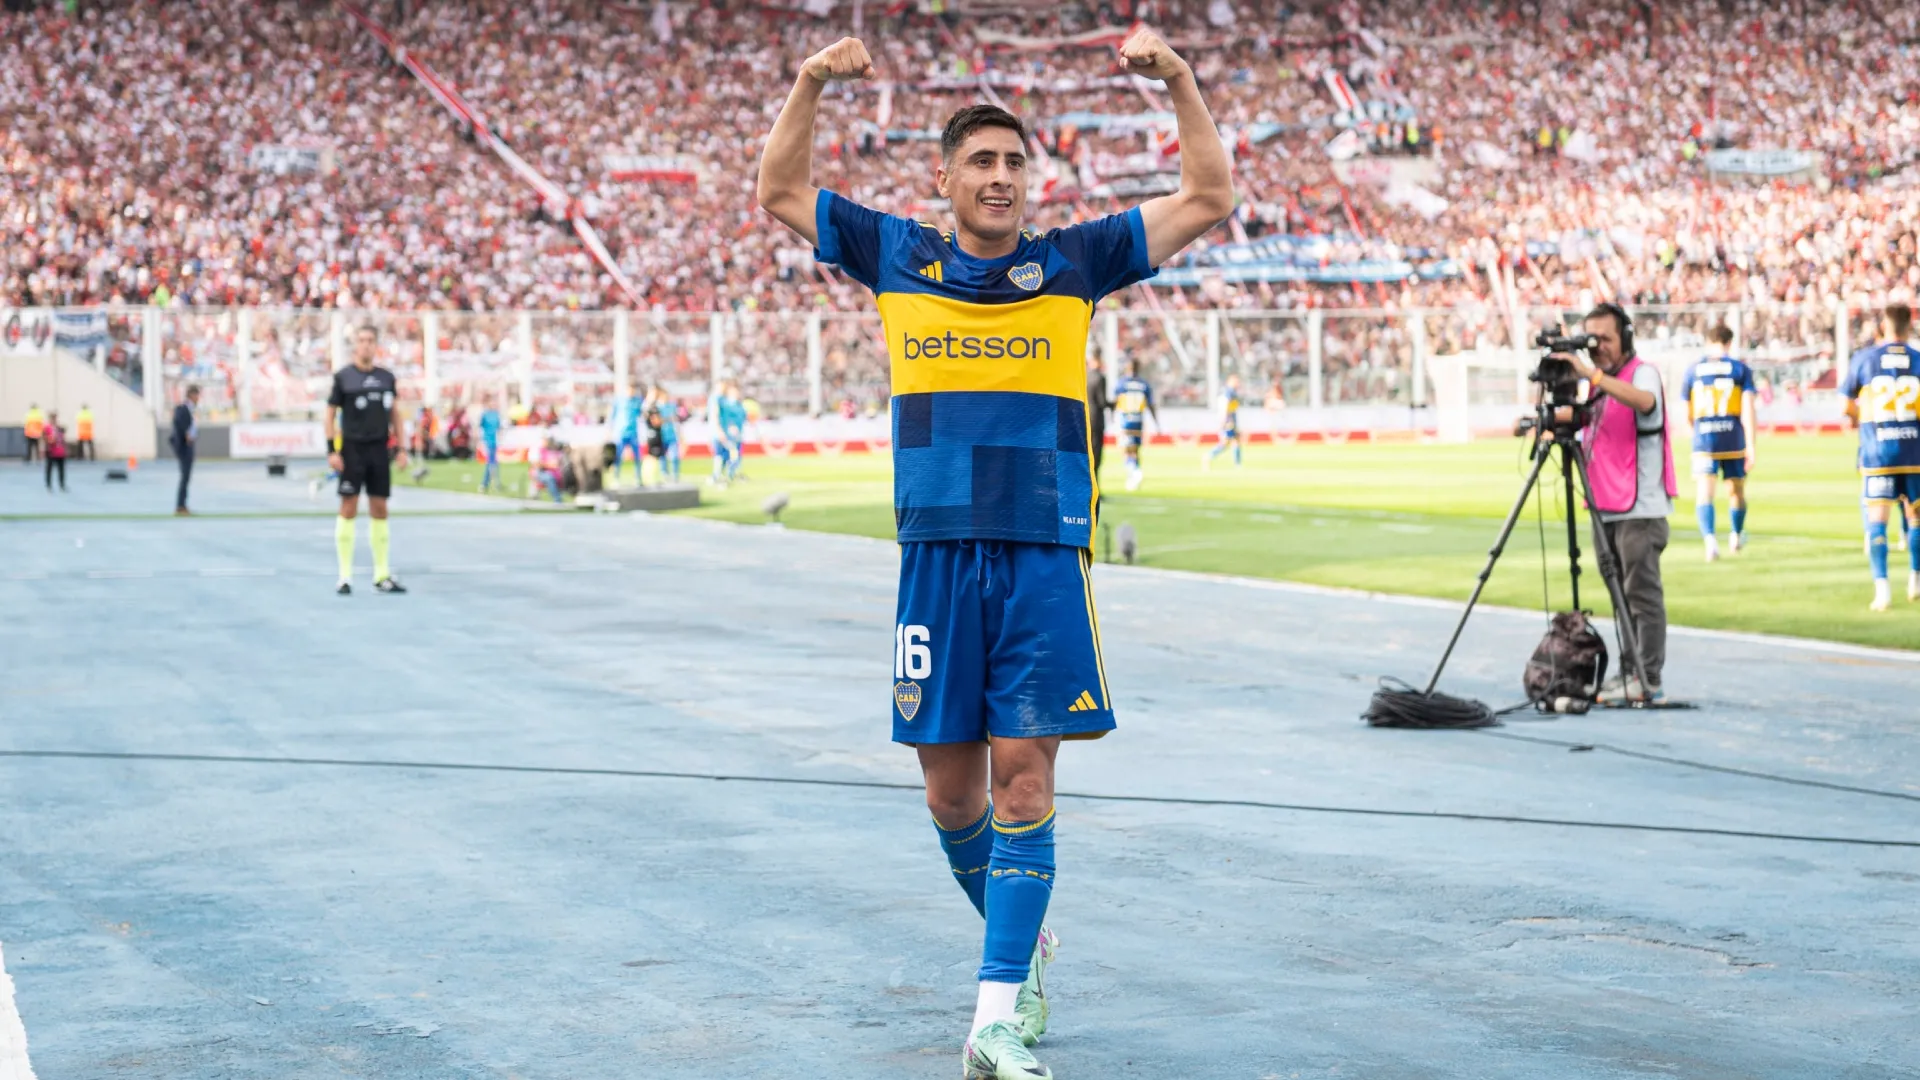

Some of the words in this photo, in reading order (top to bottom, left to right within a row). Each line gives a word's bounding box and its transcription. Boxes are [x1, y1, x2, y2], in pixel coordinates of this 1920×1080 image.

[1014, 270, 1039, 283] CABJ
[904, 331, 1050, 360] betsson
[1870, 375, 1919, 422] 22
[895, 623, 932, 680] 16
[899, 694, 918, 703] CABJ
